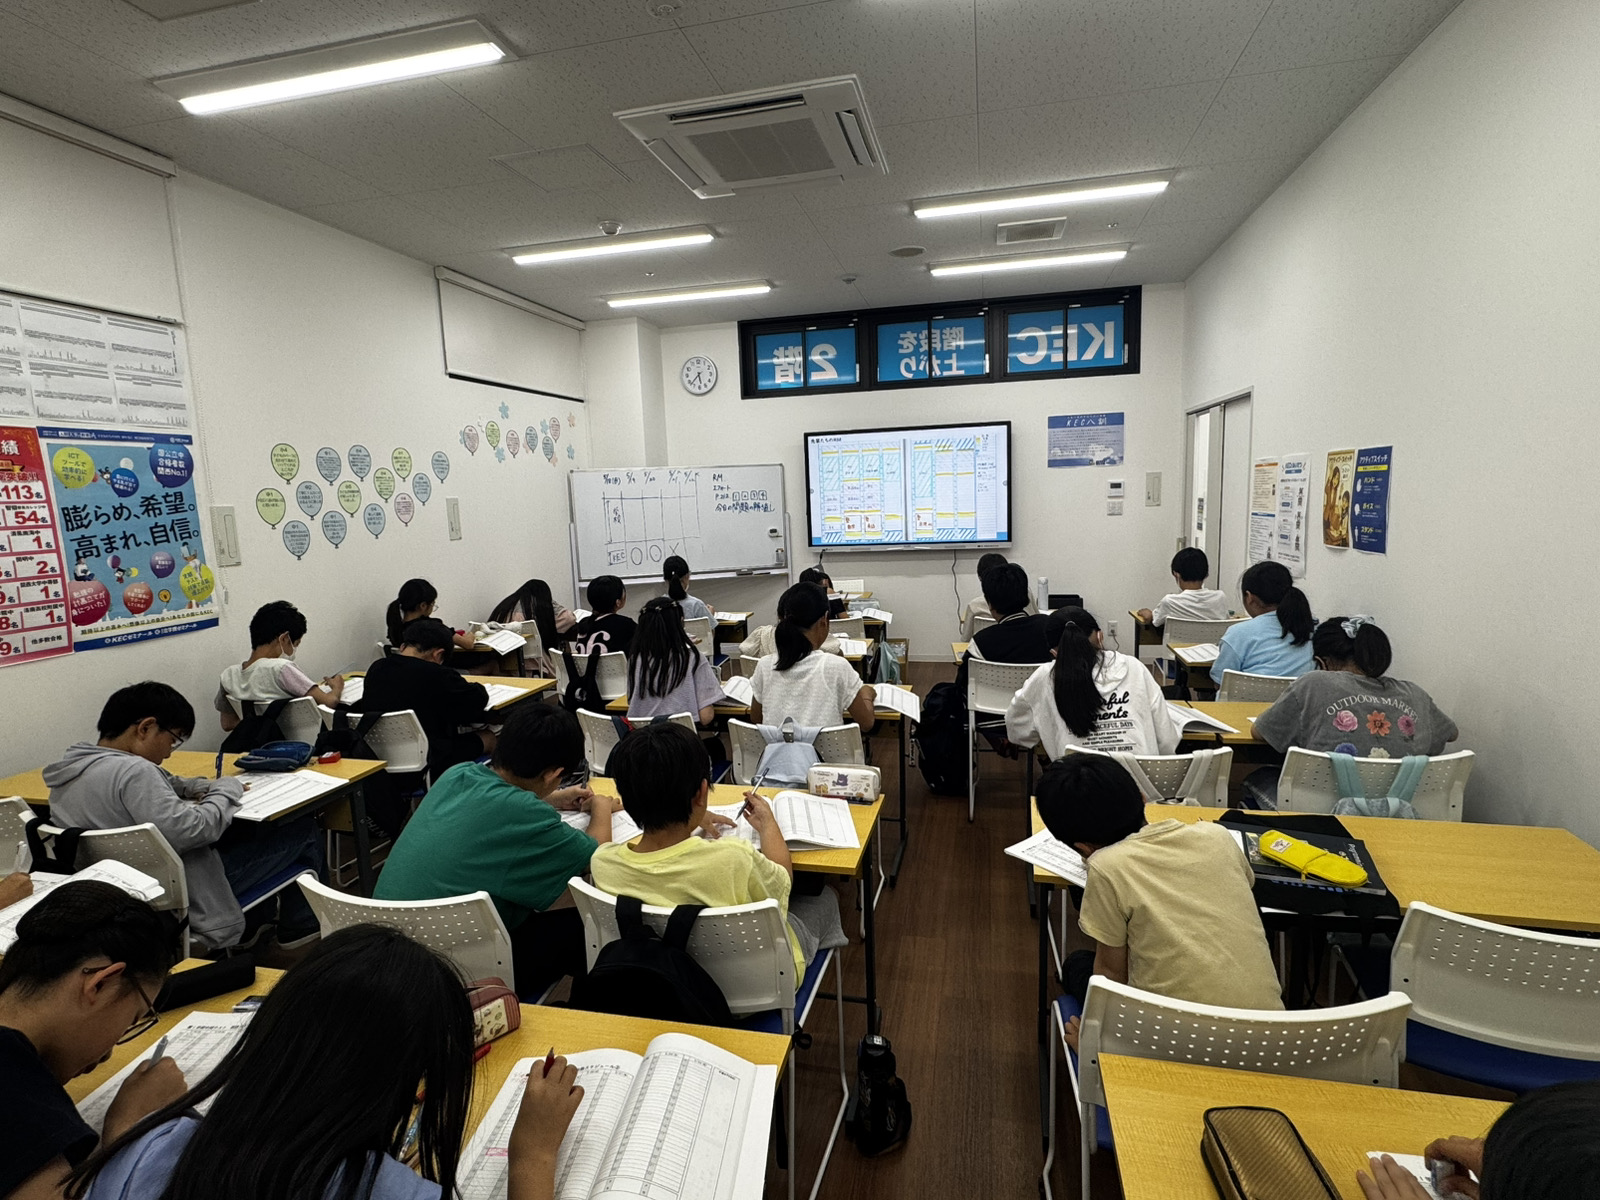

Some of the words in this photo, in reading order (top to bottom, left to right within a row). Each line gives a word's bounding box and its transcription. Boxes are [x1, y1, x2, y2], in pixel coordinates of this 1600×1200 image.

[61, 491, 195, 532] 膨らめ、希望。
[70, 517, 199, 560] 高まれ、自信。
[1326, 694, 1380, 715] OUTDOOR
